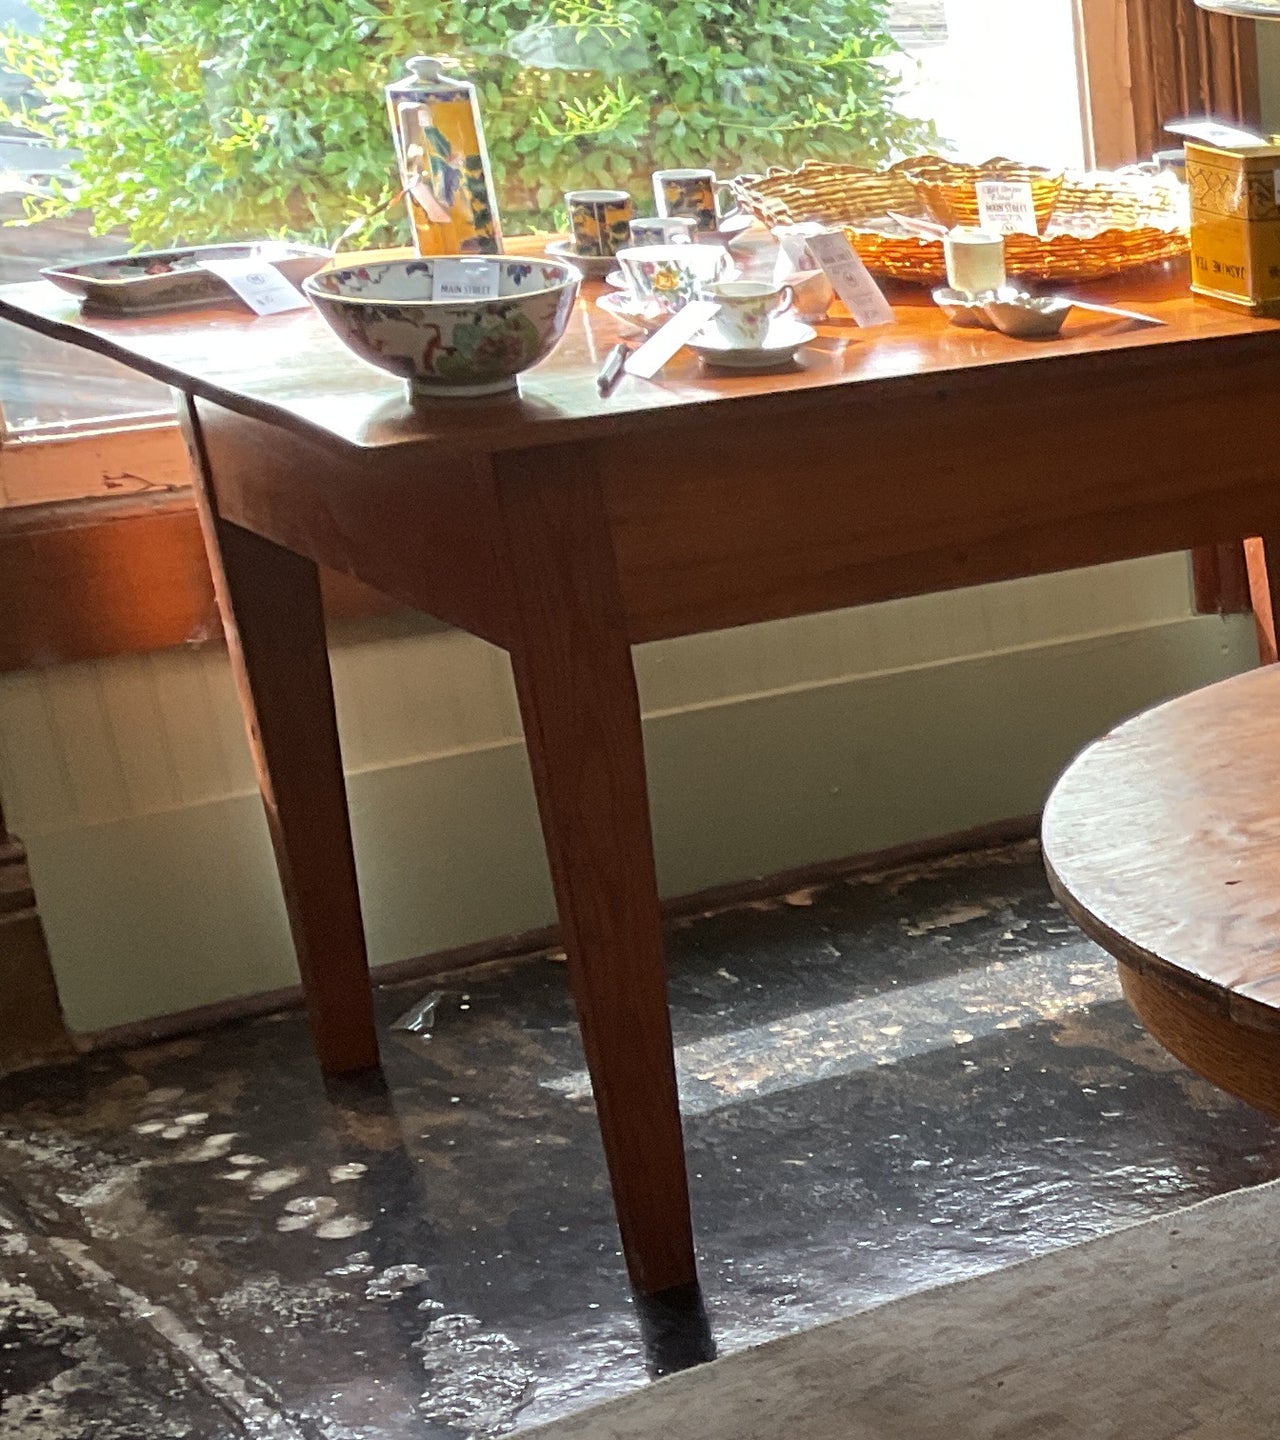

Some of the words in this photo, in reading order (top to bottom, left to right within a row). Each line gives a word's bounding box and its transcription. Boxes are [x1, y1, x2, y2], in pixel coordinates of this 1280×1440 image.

[986, 203, 1003, 212] MAIN
[1195, 255, 1209, 273] TEA
[1213, 260, 1246, 280] JASMINE
[440, 285, 462, 293] MAIN
[463, 286, 491, 294] STREET
